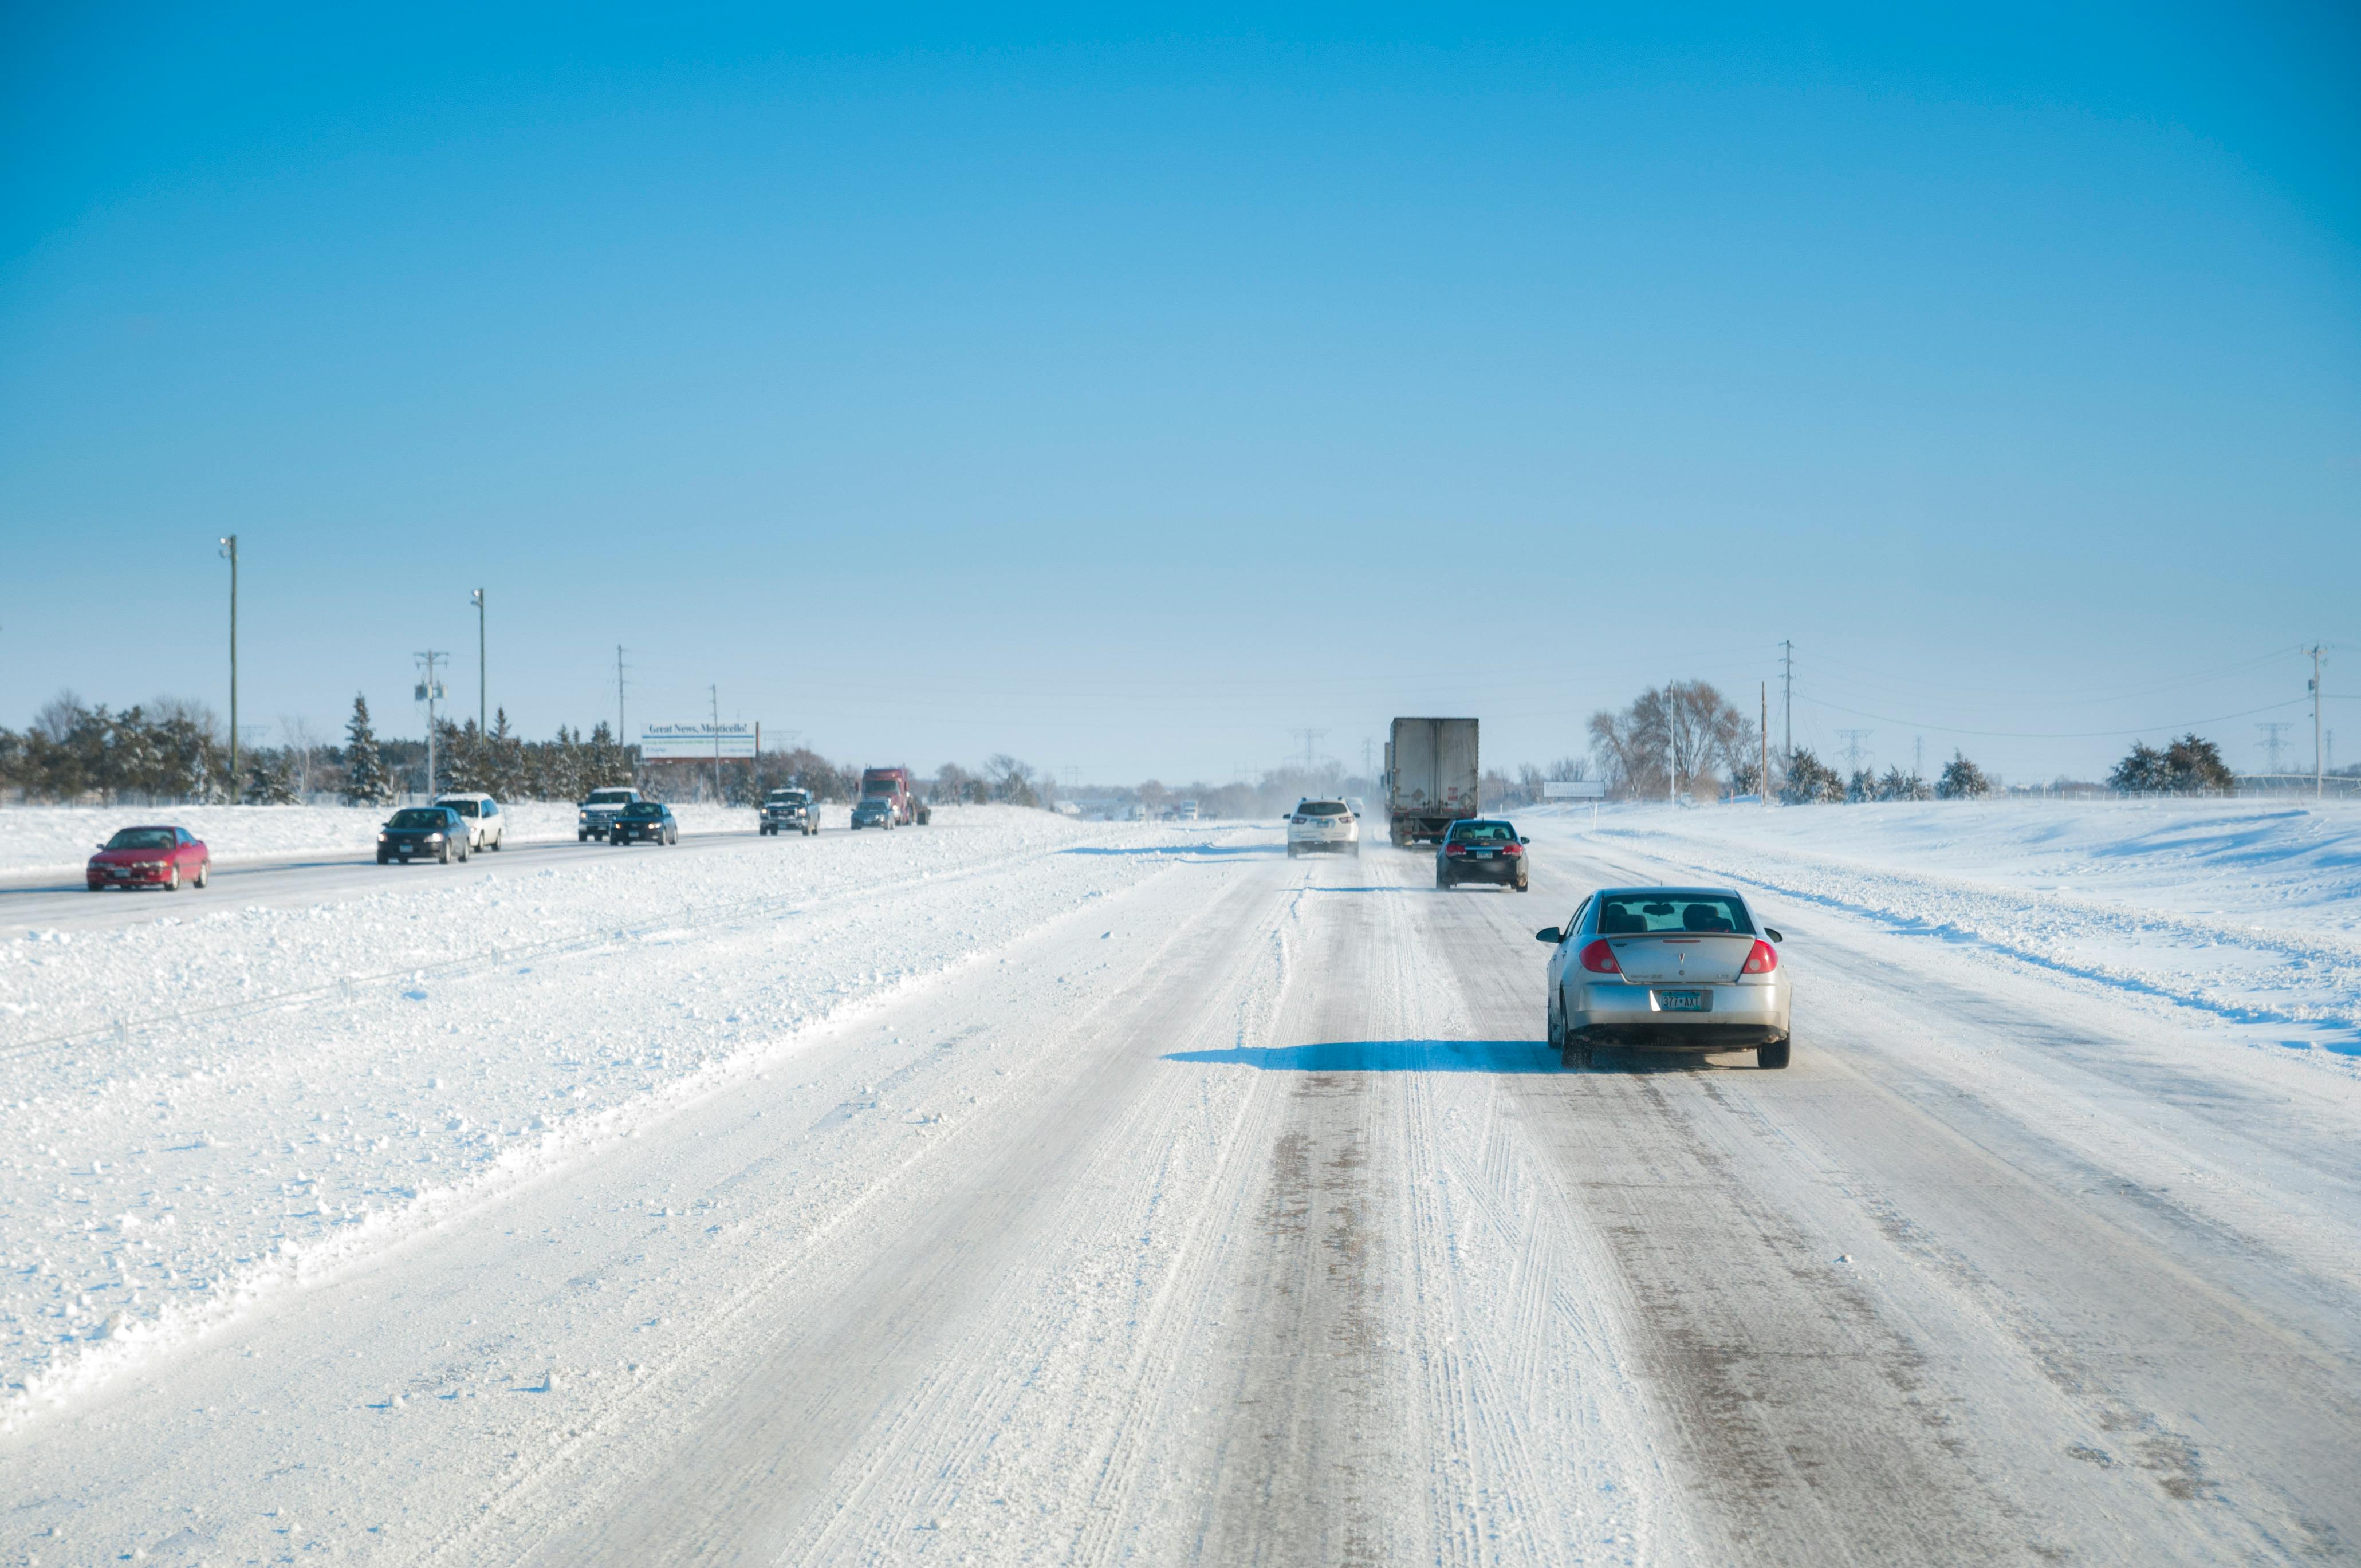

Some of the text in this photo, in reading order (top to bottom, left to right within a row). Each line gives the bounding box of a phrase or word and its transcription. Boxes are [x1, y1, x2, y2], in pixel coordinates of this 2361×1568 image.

[649, 724, 672, 734] Great
[675, 723, 698, 734] News,
[1664, 996, 1699, 1007] 377 AXT
